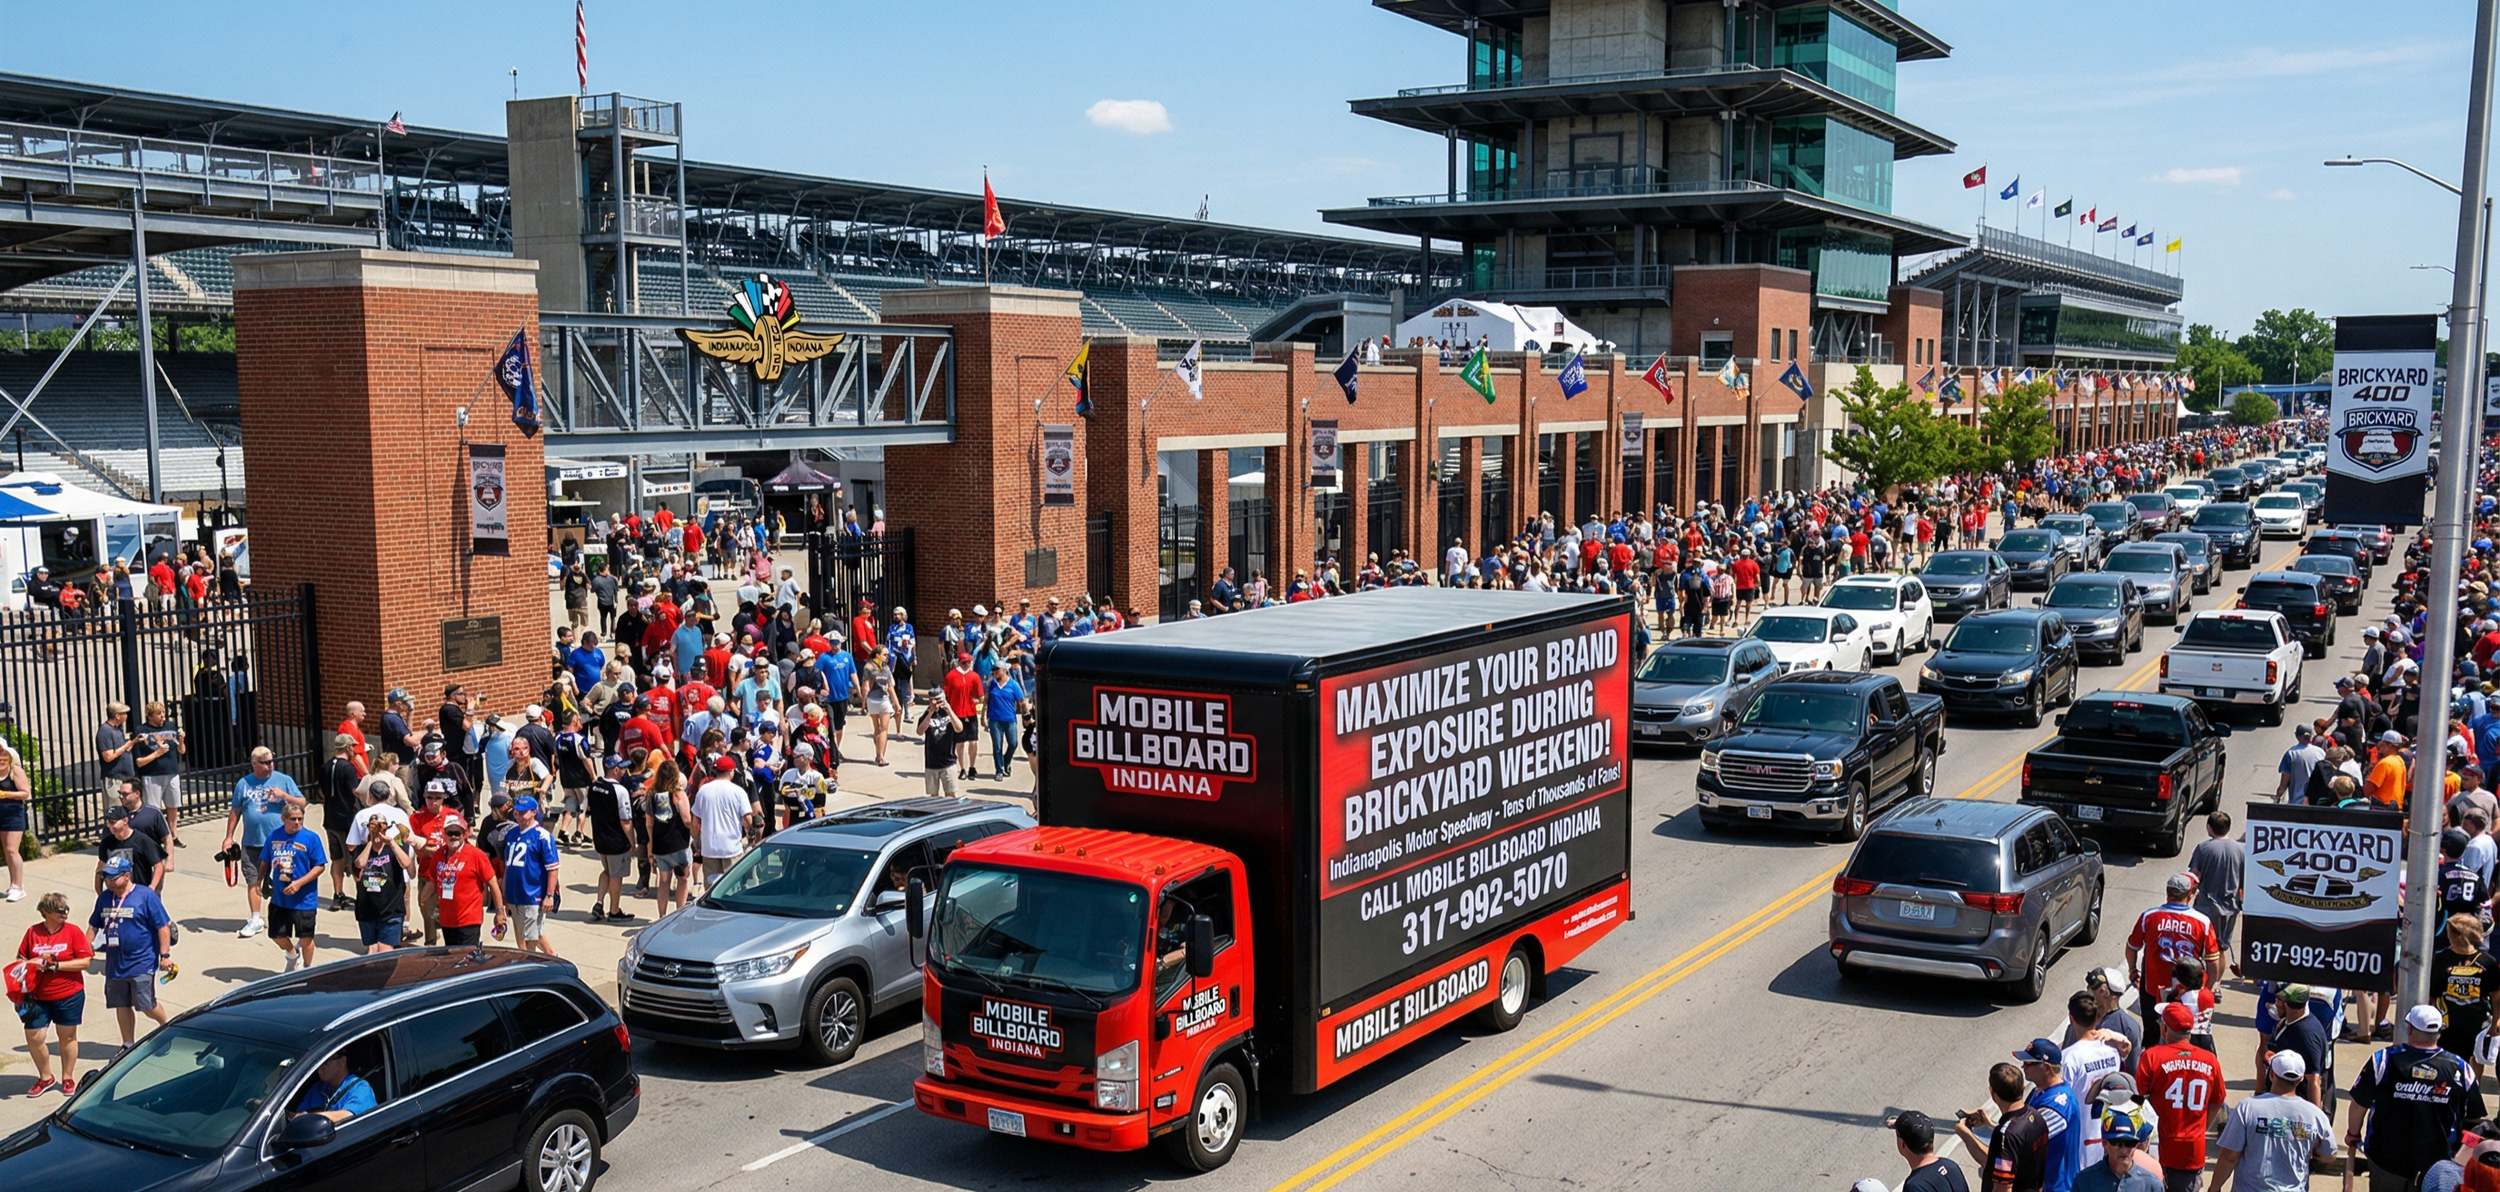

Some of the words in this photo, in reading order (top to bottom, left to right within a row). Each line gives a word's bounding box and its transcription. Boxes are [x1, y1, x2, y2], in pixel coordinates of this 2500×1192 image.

[2338, 368, 2428, 387] BRICKYARD
[2353, 385, 2411, 402] 400
[2348, 411, 2414, 427] BRICKYARD
[1336, 660, 1471, 735] MAXIMIZE
[1477, 646, 1539, 698] YOUR
[1546, 628, 1618, 682] BRAND
[1100, 693, 1225, 735] MOBILE
[1371, 702, 1504, 780] EXPOSURE
[1512, 679, 1594, 738] DURING
[1076, 727, 1249, 773] BILLBOARD
[1112, 768, 1212, 796] INDIANA
[1345, 755, 1493, 841] BRICKYARD
[1499, 718, 1611, 789] WEEKEND!
[1330, 838, 1403, 881] Indianapolis
[1405, 829, 1438, 854] Motor
[1441, 809, 1493, 844] Speedway
[1502, 799, 1524, 819] Tens
[1526, 790, 1537, 812] of
[1537, 774, 1586, 807] Thousands
[1587, 769, 1597, 790] of
[1598, 761, 1621, 786] Fans!
[1360, 883, 1402, 922] CALL
[1406, 855, 1465, 904] MOBILE
[1469, 826, 1546, 877] BILLBOARD
[1549, 805, 1601, 847] INDIANA
[2252, 825, 2394, 864] BRICKYARD
[2284, 851, 2357, 873] 400
[1402, 851, 1568, 955] 317-992-5070
[2250, 941, 2382, 975] 317-992-5070
[986, 1000, 1048, 1027] MOBILE
[1336, 1000, 1400, 1058] MOBILE
[1404, 960, 1489, 1025] BILLBOARD
[973, 1016, 1060, 1047] BILLBOARD
[2165, 1077, 2208, 1111] 40
